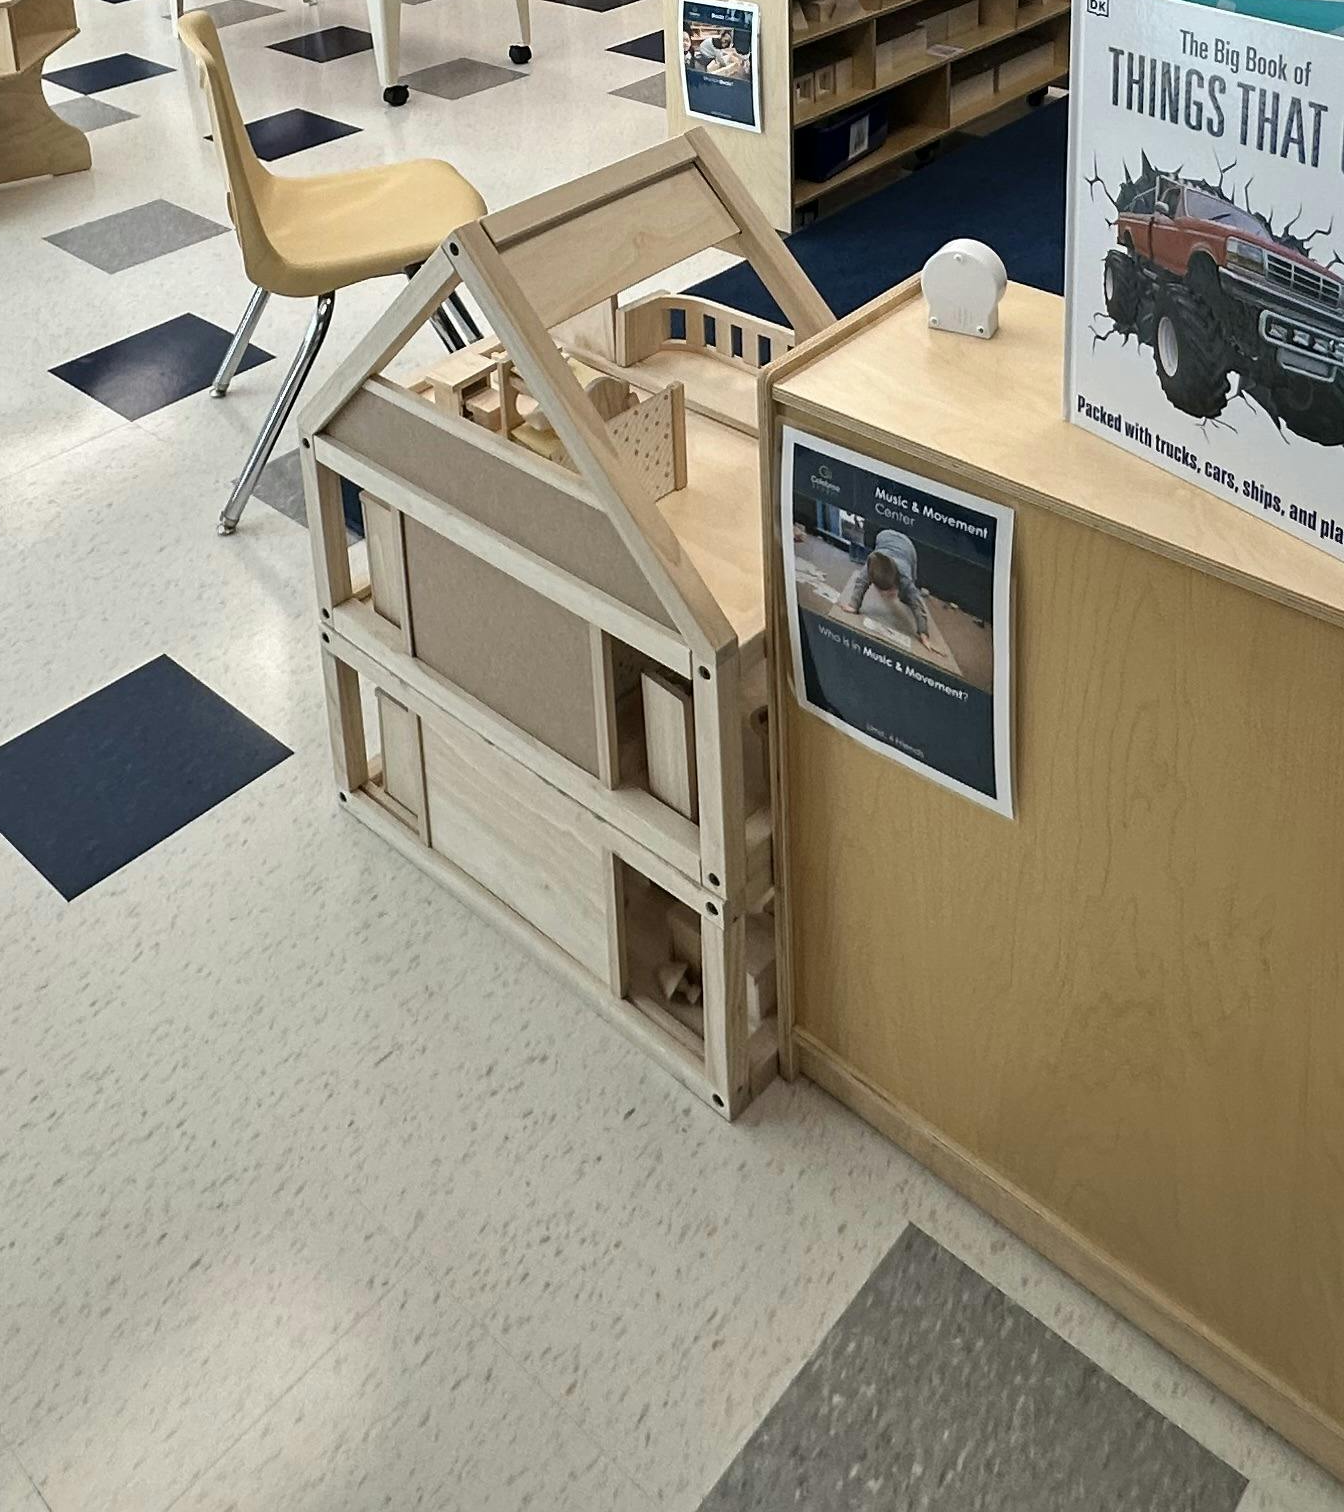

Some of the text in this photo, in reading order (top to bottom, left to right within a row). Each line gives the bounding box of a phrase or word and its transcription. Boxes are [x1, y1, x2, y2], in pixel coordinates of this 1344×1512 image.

[1180, 29, 1312, 87] The Big Book of
[1108, 46, 1227, 139] THINGS
[1236, 81, 1328, 168] THAT
[1077, 394, 1121, 433] Packed
[1124, 421, 1152, 448] with
[1155, 434, 1202, 474] trucks,
[1204, 461, 1239, 493] cars,
[1242, 479, 1286, 517] ships,
[1289, 503, 1316, 531] and
[874, 487, 988, 540] Music & Movement
[874, 502, 915, 527] Center
[818, 624, 841, 643] Who
[851, 639, 861, 651] in
[862, 646, 893, 668] Music
[895, 661, 903, 673] &
[905, 665, 969, 703] Movement?
